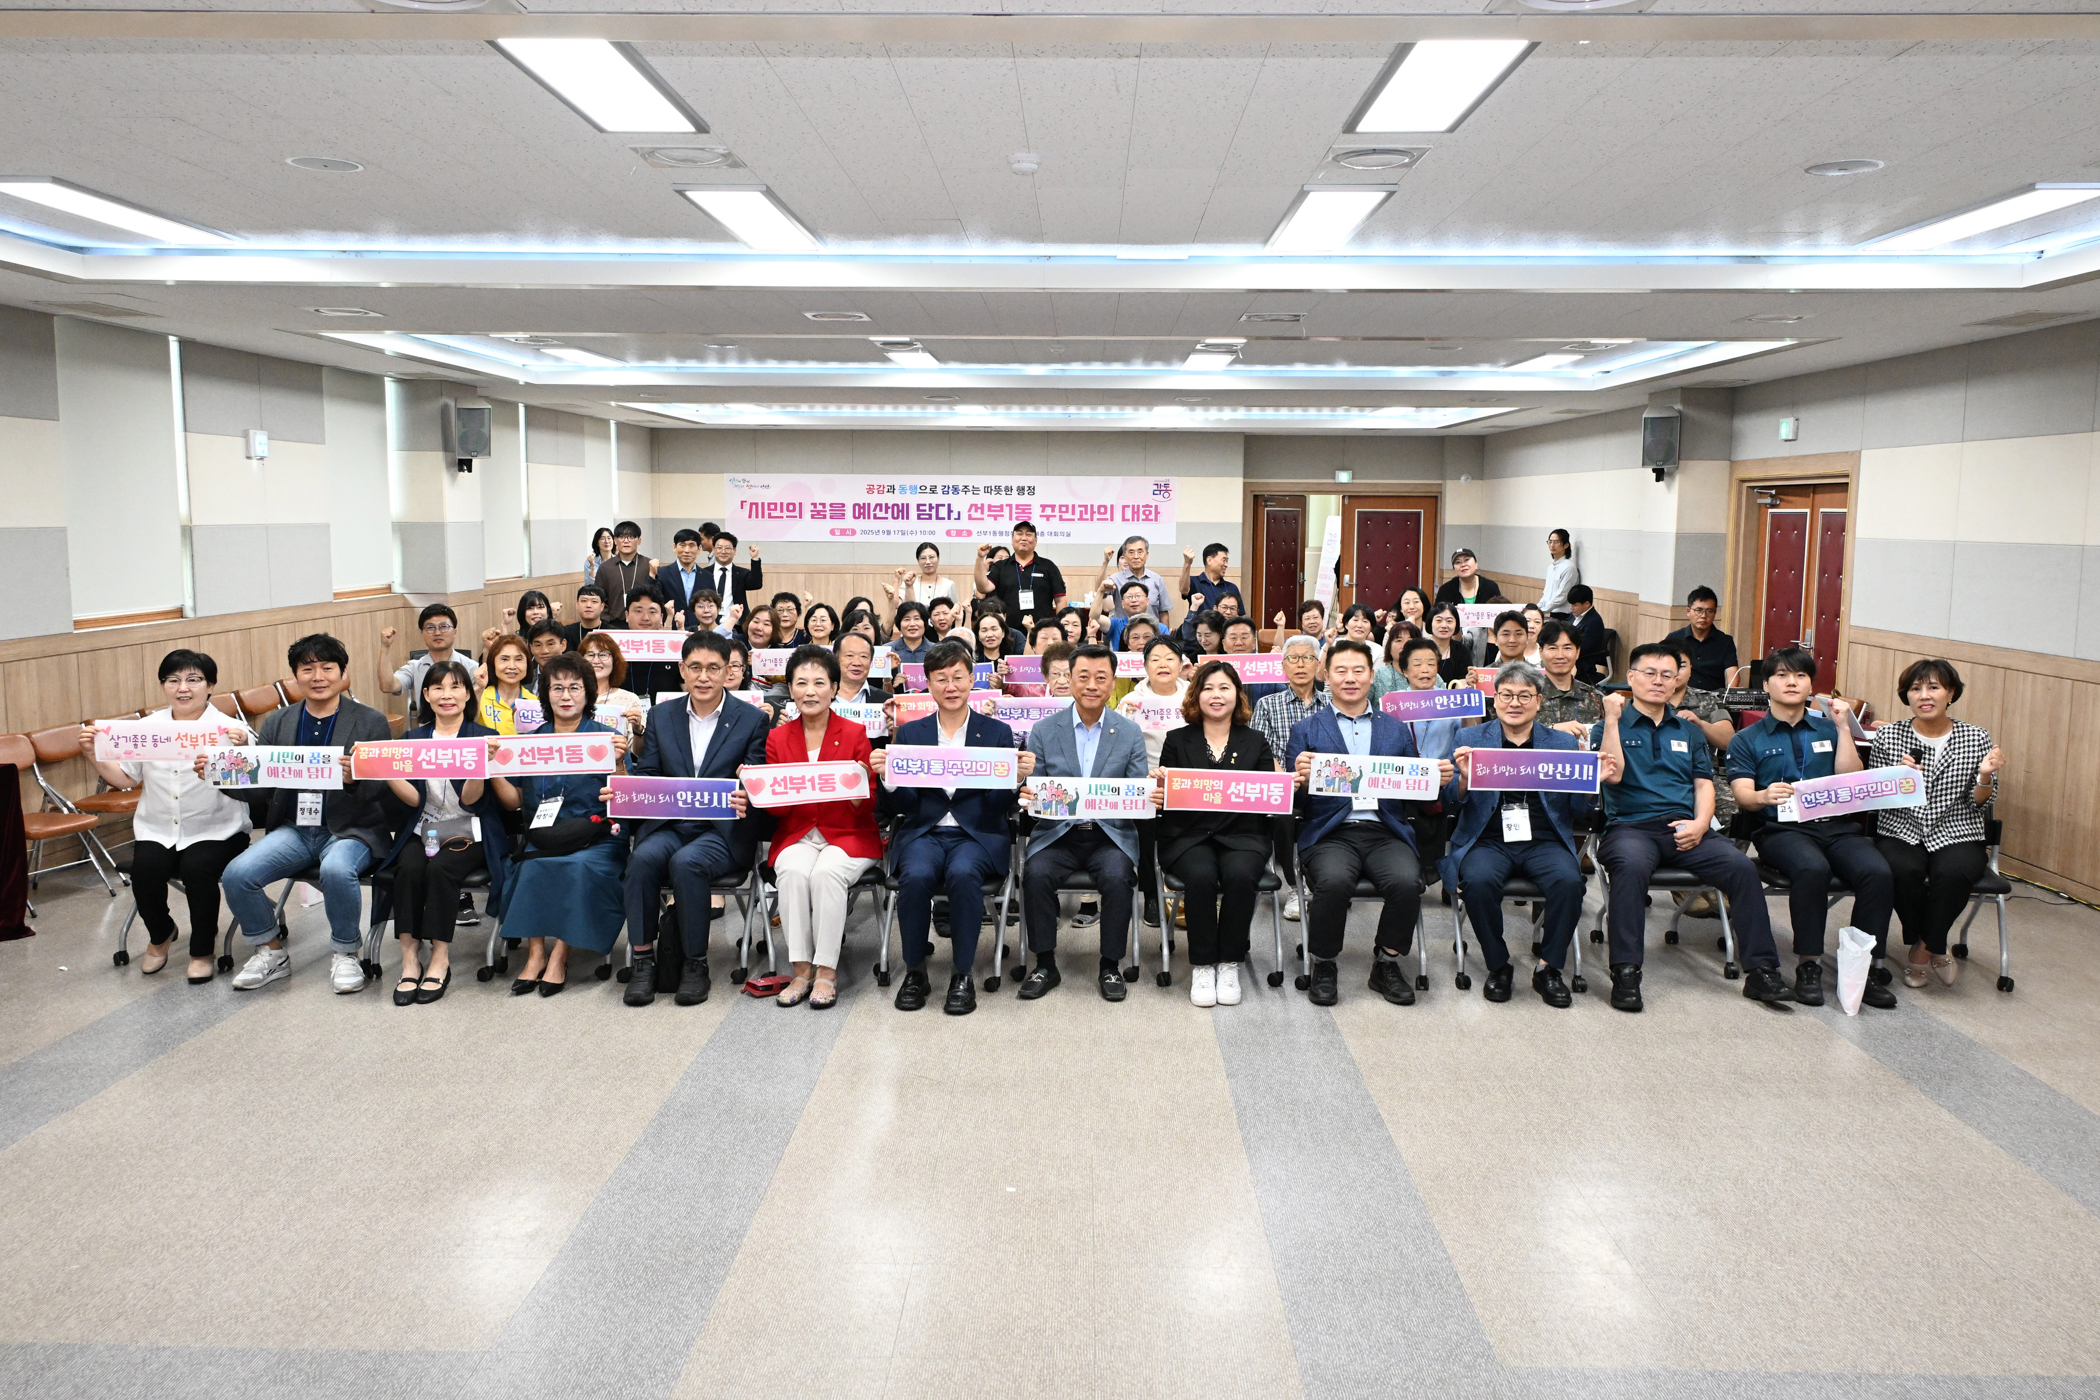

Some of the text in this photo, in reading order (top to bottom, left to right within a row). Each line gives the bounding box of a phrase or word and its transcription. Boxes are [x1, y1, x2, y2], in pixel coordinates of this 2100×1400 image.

[866, 484, 1036, 496] 공감과 동행으로 감동주는 따뜻한 행정
[1152, 483, 1172, 499] 감동
[740, 500, 1160, 522] 「시민의 꿈을 예산에 담다」 선부1동 주민과의 대화
[834, 528, 841, 536] 일
[845, 528, 852, 536] 시
[892, 529, 918, 537] 17일(수)
[1464, 612, 1498, 620] 살기좋은 동네
[618, 639, 666, 654] 선부1동
[760, 657, 784, 668] 살기좋은
[874, 656, 886, 669] 꿈
[1118, 659, 1144, 672] 선부
[1243, 660, 1284, 676] 선부1동
[1478, 674, 1492, 682] 꿈과
[900, 702, 916, 712] 꿈과
[1386, 693, 1480, 712] 꿈과 희망의 도시 안산시!
[520, 710, 548, 723] 선부
[864, 708, 881, 718] 꿈을
[998, 708, 1042, 720] 선부1동
[1140, 708, 1172, 721] 살기좋은
[109, 732, 219, 750] 살기좋은 동네 선부1동
[268, 752, 332, 764] 시민의 꿈을
[358, 747, 414, 760] 꿈과 희망의
[416, 748, 478, 770] 선부1동
[518, 744, 584, 766] 선부1동
[266, 766, 334, 779] 예산에 담다
[392, 760, 414, 772] 마을
[892, 758, 1010, 778] 선부1동 주민의 꿈
[1371, 762, 1430, 776] 시민의 꿈을
[1476, 762, 1594, 780] 꿈과 희망의 도시 안산시!
[770, 773, 837, 796] 선부1동
[1086, 784, 1146, 797] 시민의 꿈을
[1172, 778, 1224, 791] 꿈과 희망의
[1368, 776, 1430, 792] 예산에 담다
[614, 790, 630, 804] 꿈과
[631, 791, 656, 804] 희망의
[658, 794, 674, 804] 도시
[1203, 792, 1222, 804] 마을
[1226, 782, 1284, 805] 선부1동
[1800, 777, 1916, 809] 선부1동 주민의 꿈
[1084, 798, 1147, 810] 예산에 담다
